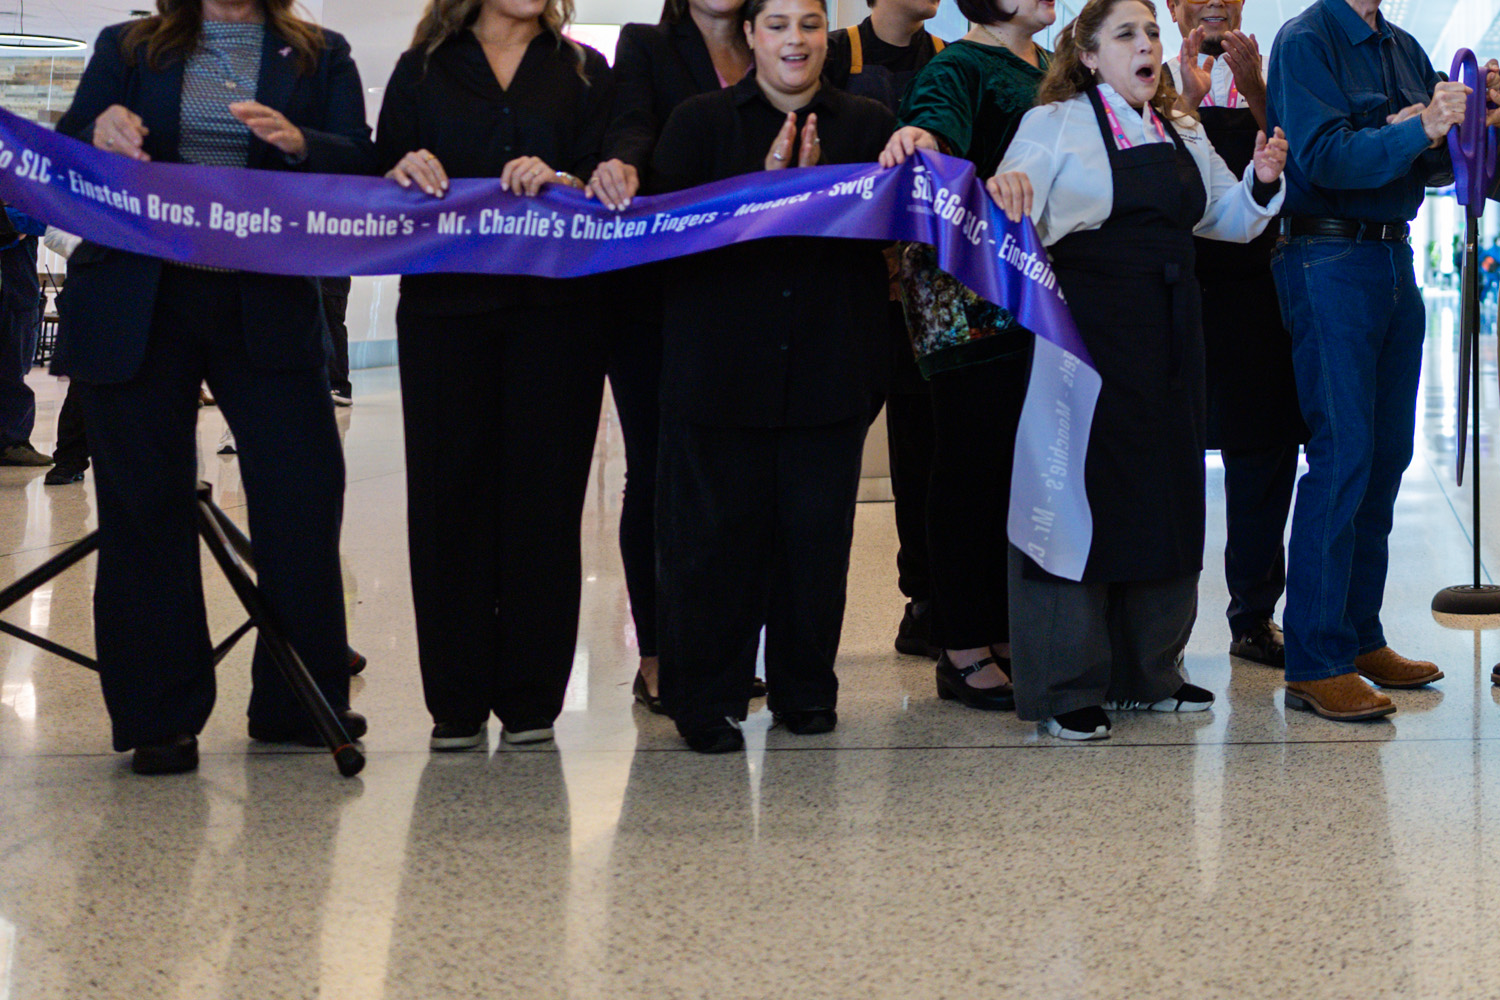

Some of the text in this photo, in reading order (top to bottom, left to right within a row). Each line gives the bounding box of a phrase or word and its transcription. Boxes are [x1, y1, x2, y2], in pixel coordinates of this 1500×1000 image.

[15, 149, 51, 184] SLC
[68, 169, 141, 215] Einstein
[148, 194, 200, 226] Bros.
[210, 203, 281, 237] Bagels
[307, 211, 413, 236] Moochie's
[438, 212, 471, 234] Mr.
[479, 209, 565, 237] Charlie's
[571, 214, 647, 240] Chicken
[652, 212, 718, 233] Fingers
[828, 176, 877, 200] Swig
[933, 188, 966, 226] &Go
[997, 233, 1057, 290] Einstein
